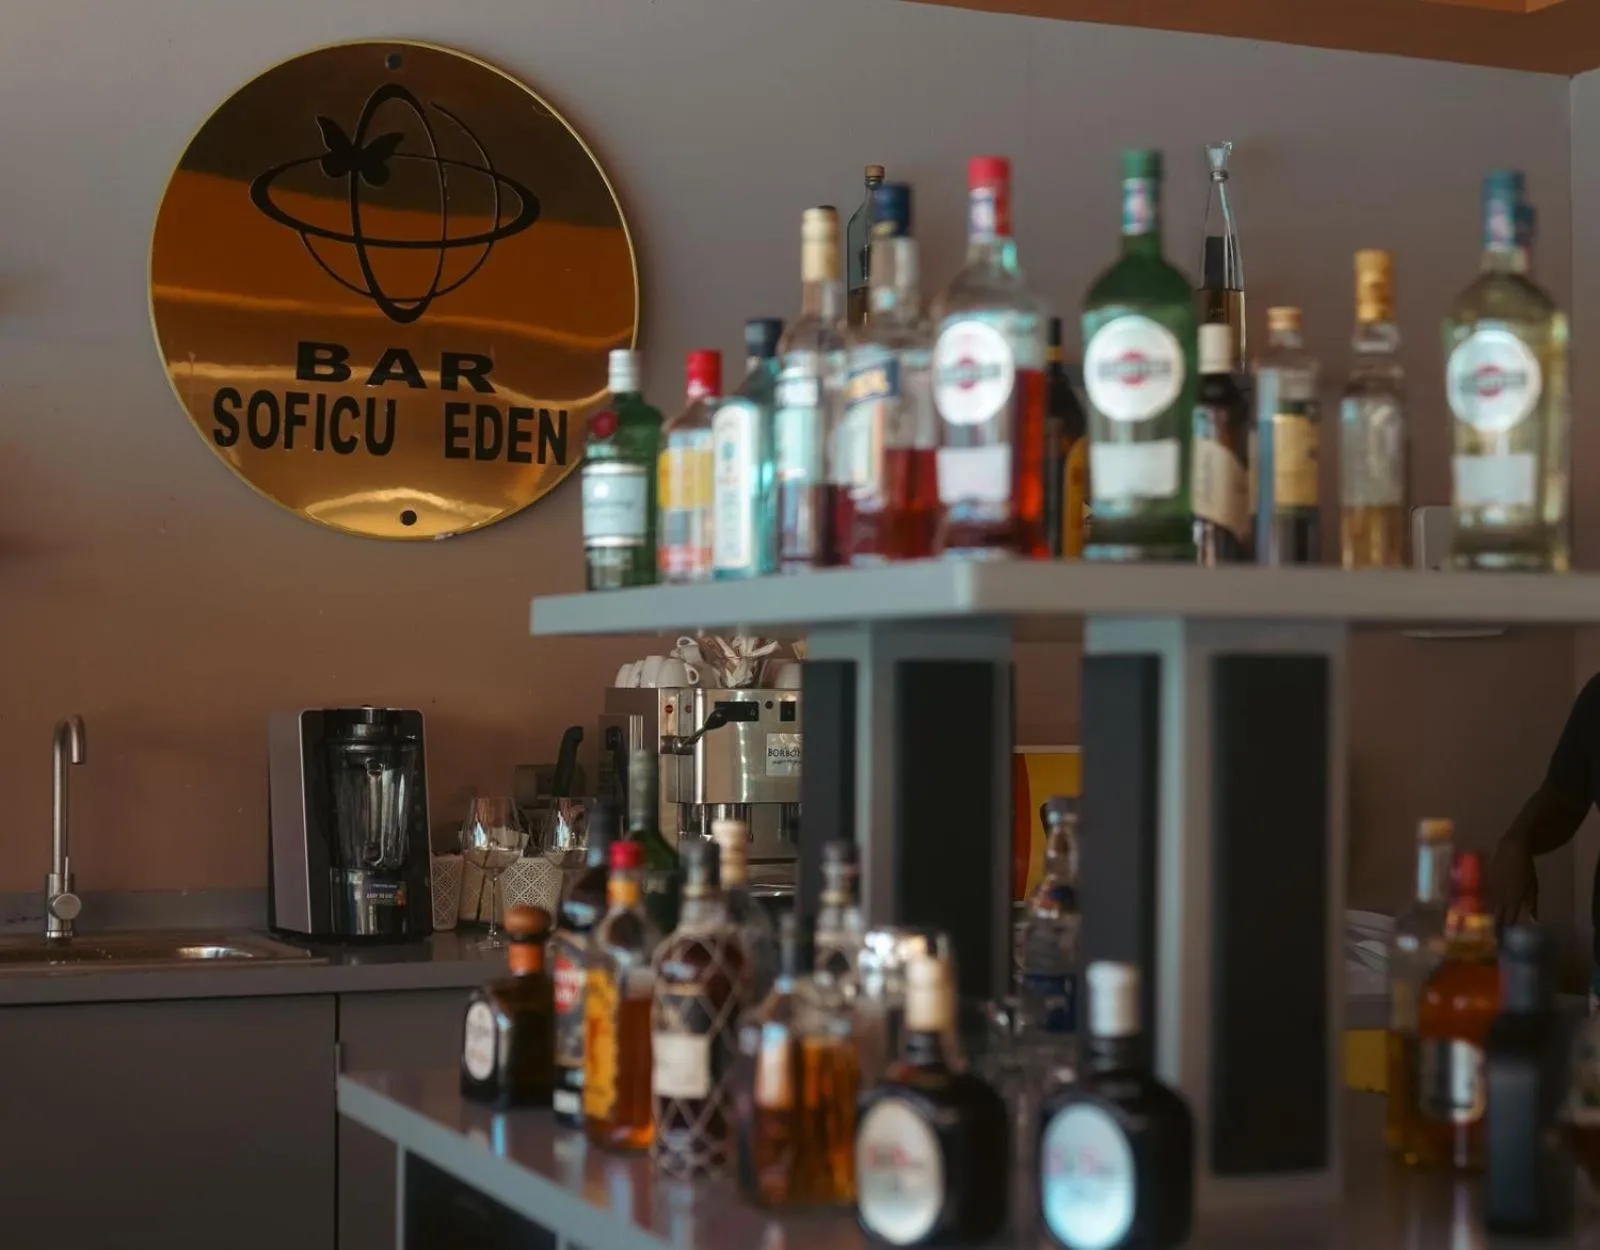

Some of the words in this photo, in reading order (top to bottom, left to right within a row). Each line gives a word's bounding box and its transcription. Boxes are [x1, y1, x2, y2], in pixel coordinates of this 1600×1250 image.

[296, 341, 497, 393] BAR
[212, 387, 396, 456] SOFICU
[445, 402, 568, 466] EDEN
